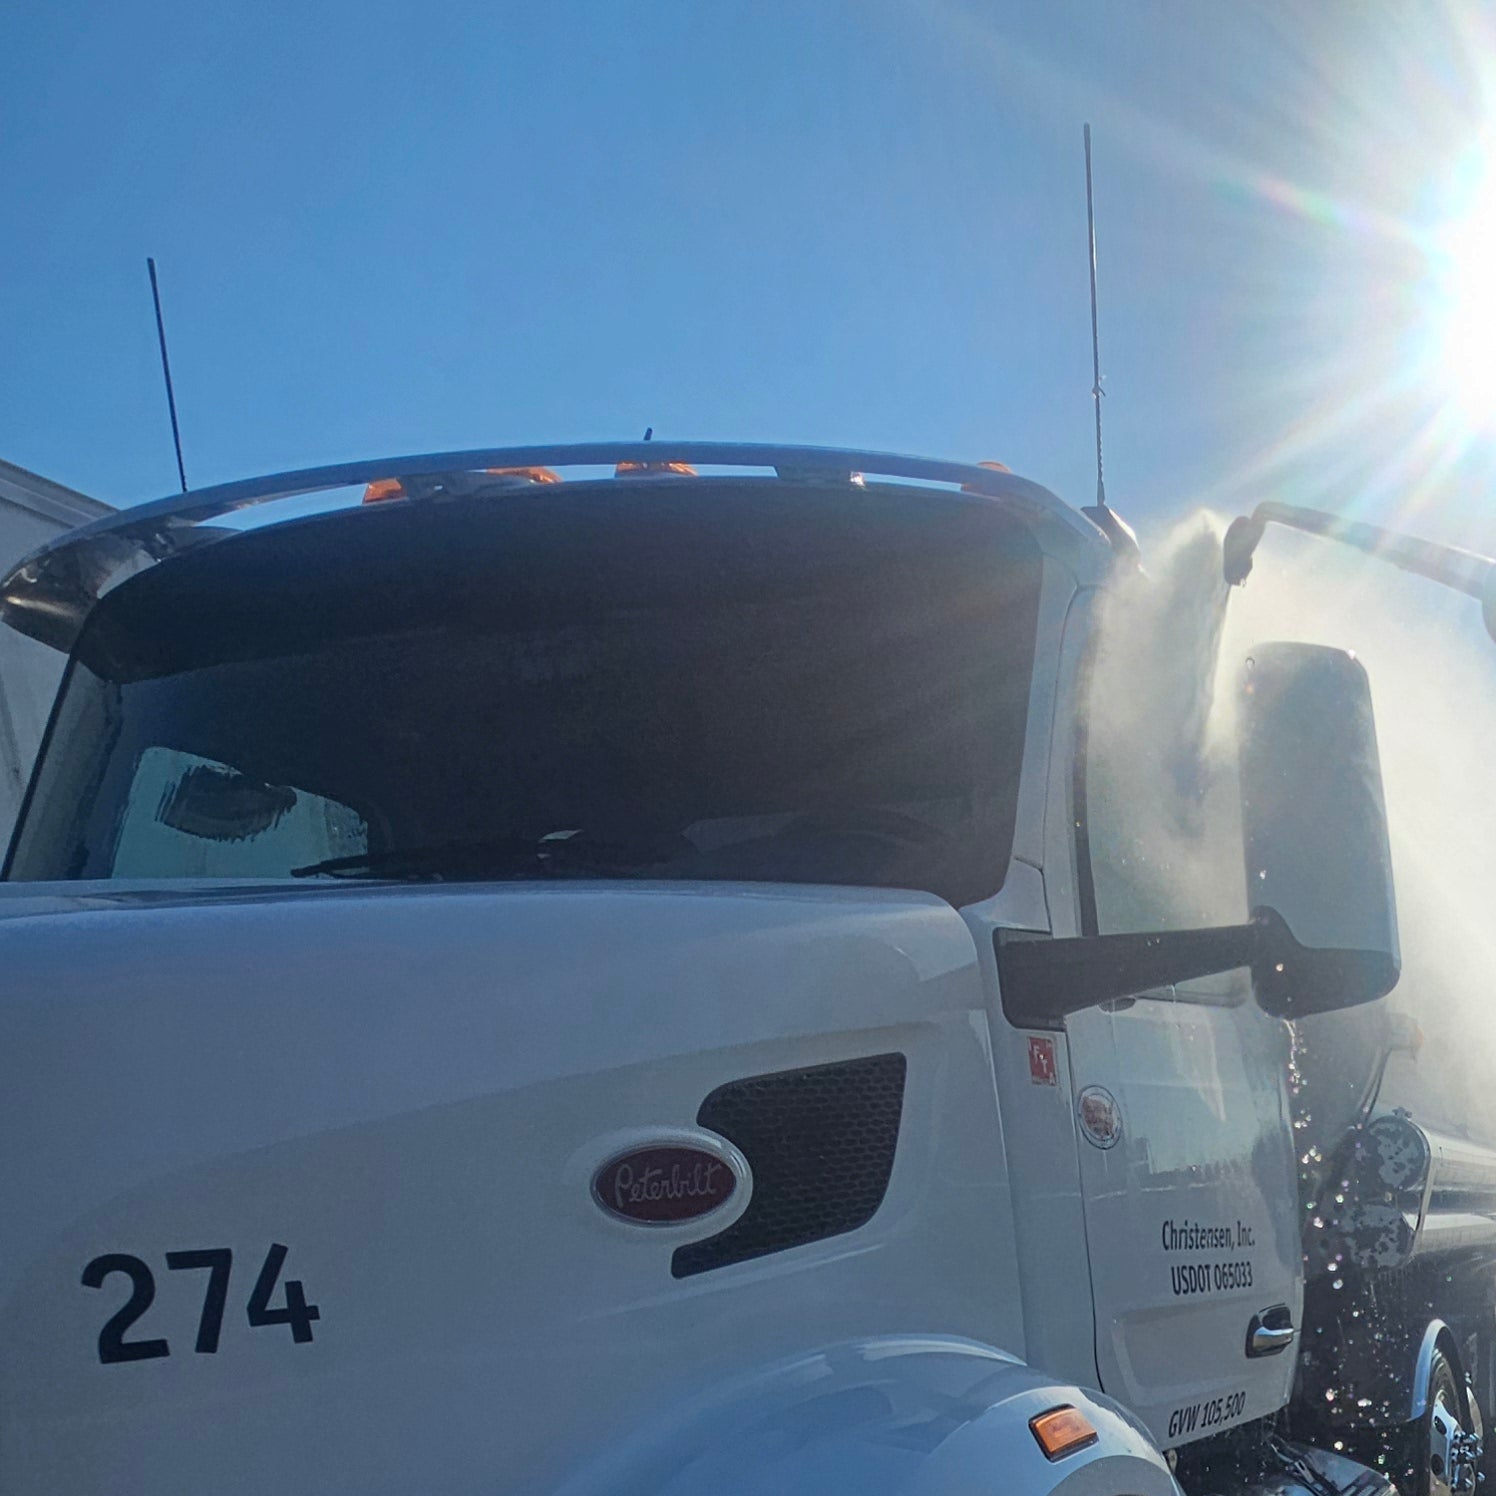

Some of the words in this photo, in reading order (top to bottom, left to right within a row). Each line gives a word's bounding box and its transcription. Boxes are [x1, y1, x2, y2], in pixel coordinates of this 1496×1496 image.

[615, 1164, 721, 1208] Peterbilt
[1162, 1220, 1235, 1251] Christensen,
[1237, 1220, 1255, 1246] Inc.
[1171, 1264, 1211, 1295] USDOT
[1214, 1261, 1253, 1291] 065033
[81, 1243, 320, 1364] 274
[1168, 1404, 1201, 1437] GVW
[1201, 1391, 1246, 1427] 105,500
